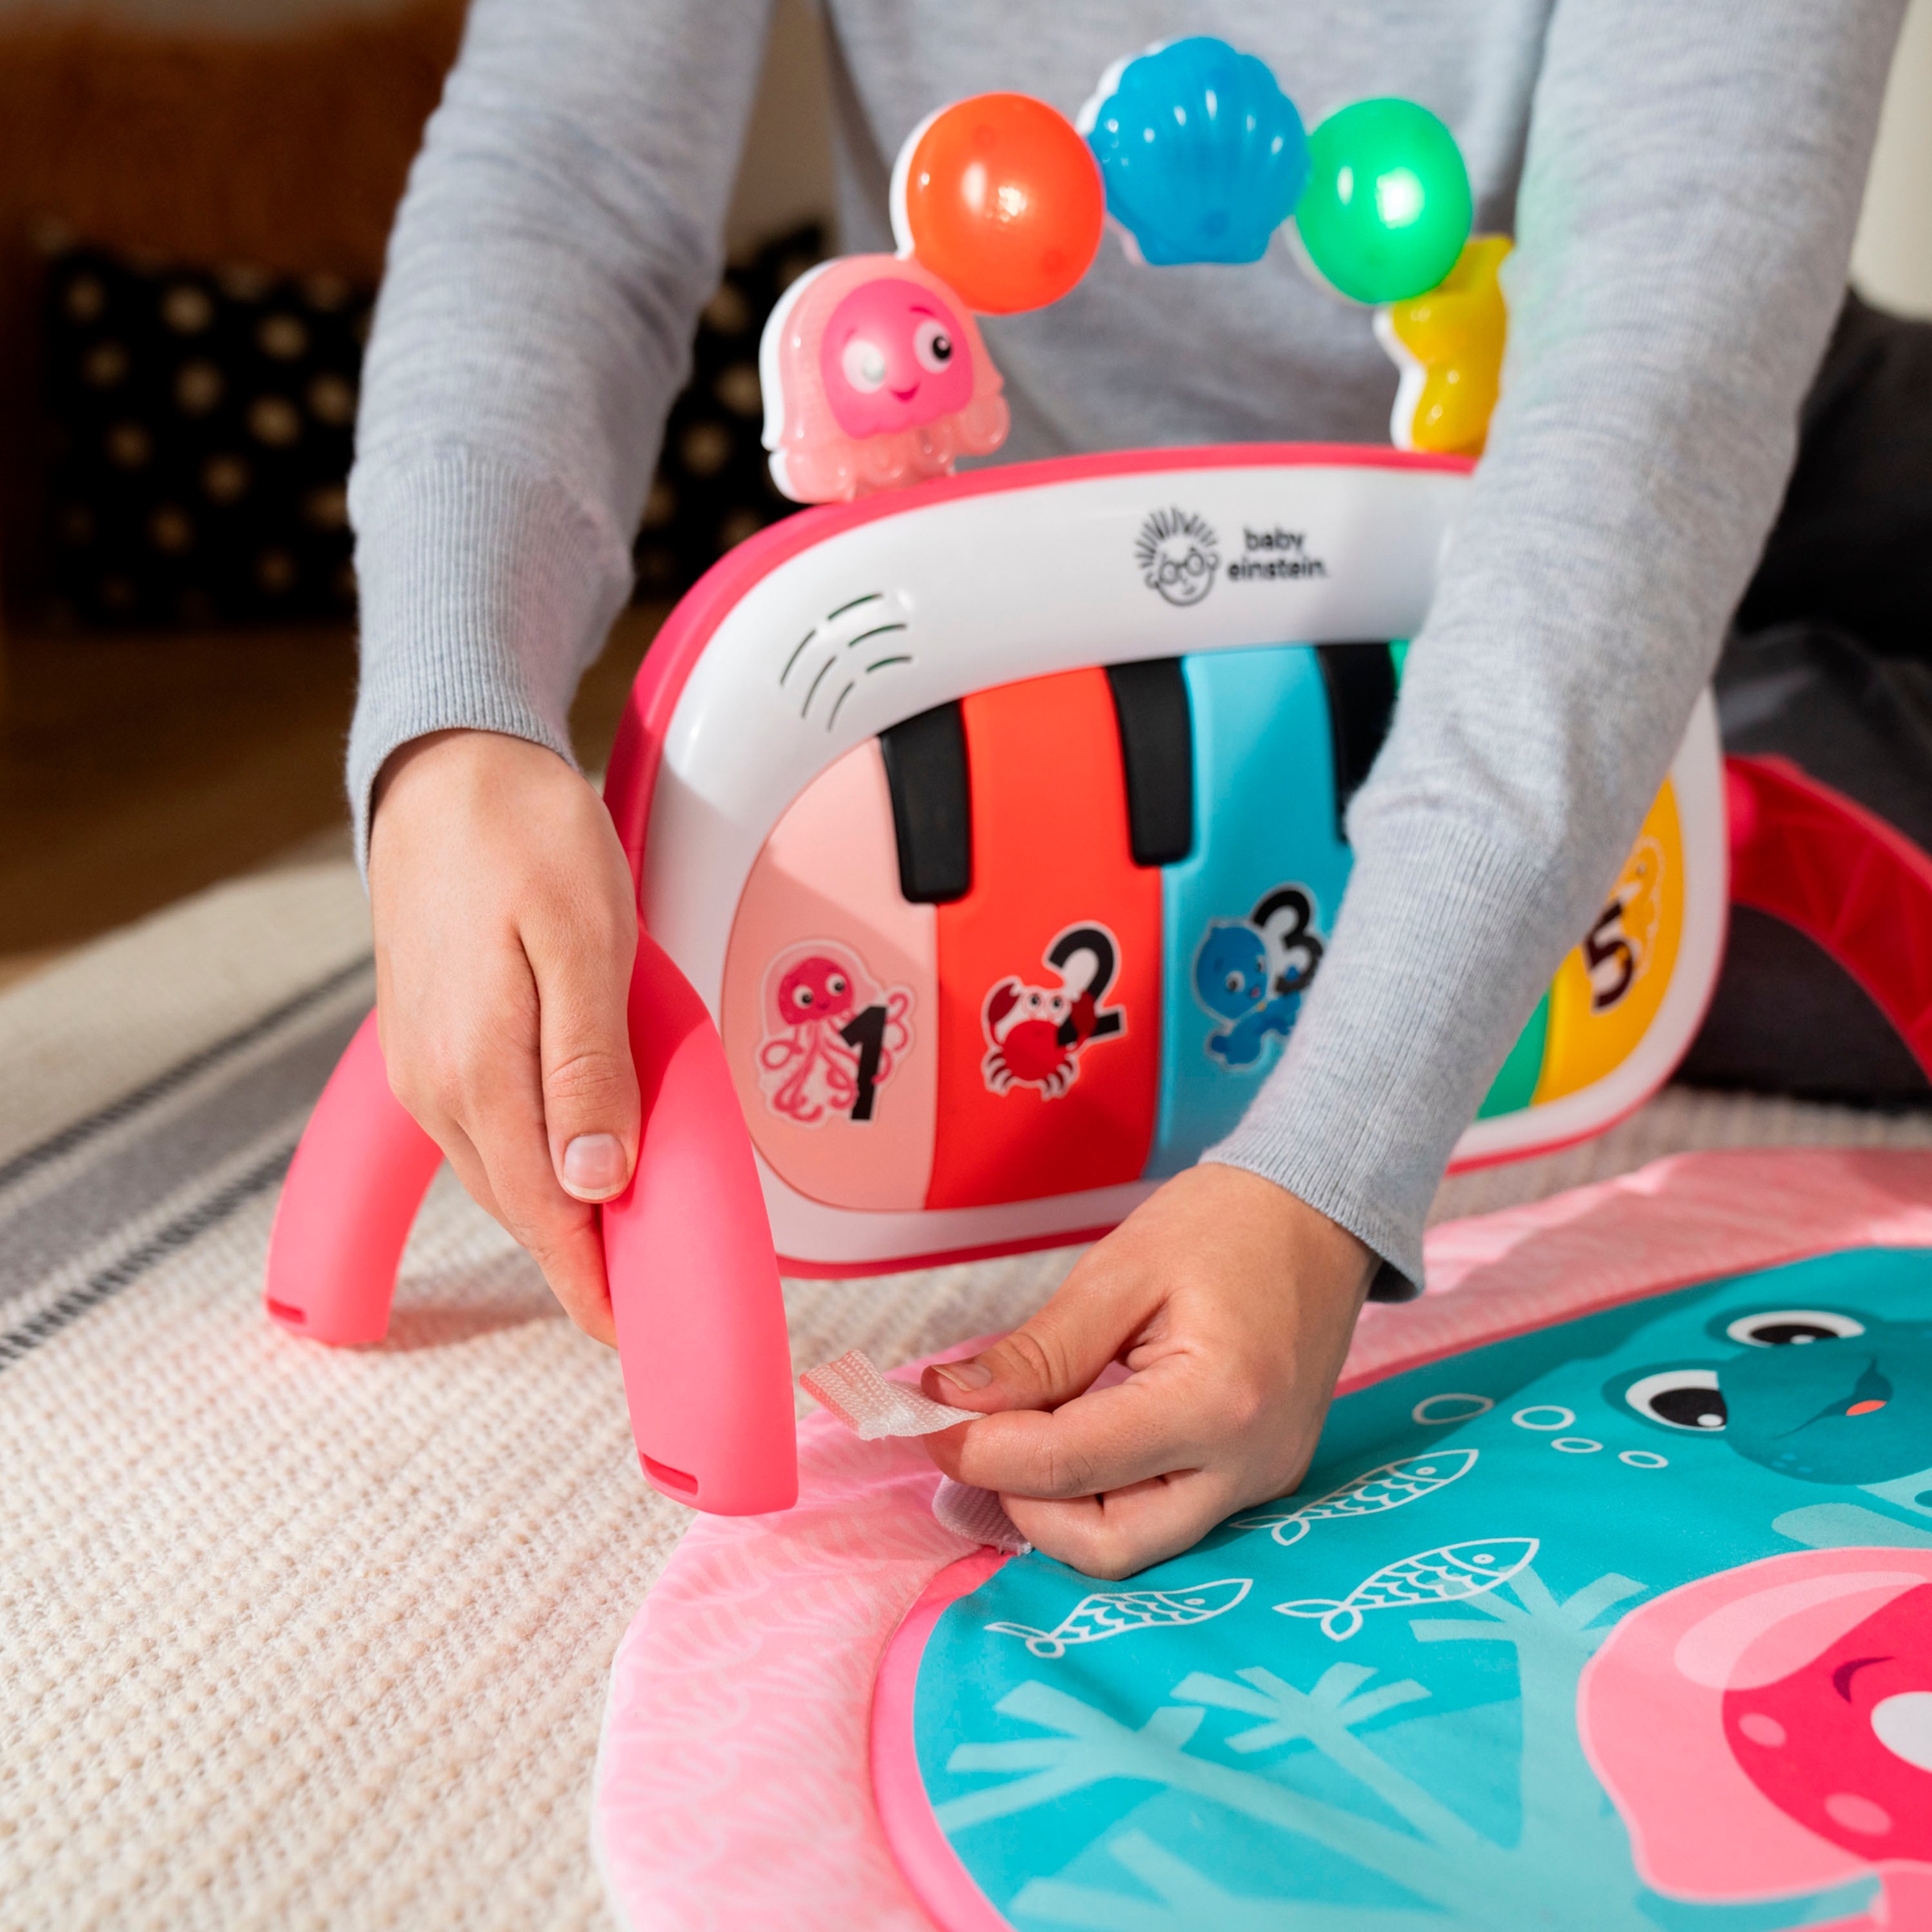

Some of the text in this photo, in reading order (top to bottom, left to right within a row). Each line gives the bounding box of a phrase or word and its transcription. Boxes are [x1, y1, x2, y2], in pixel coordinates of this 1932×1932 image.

[1227, 557, 1326, 580] einstein
[1244, 526, 1305, 551] baby
[1048, 927, 1122, 1047] 2
[1253, 888, 1324, 993] 3
[1584, 901, 1636, 1010] 5
[840, 1005, 888, 1121] 1
